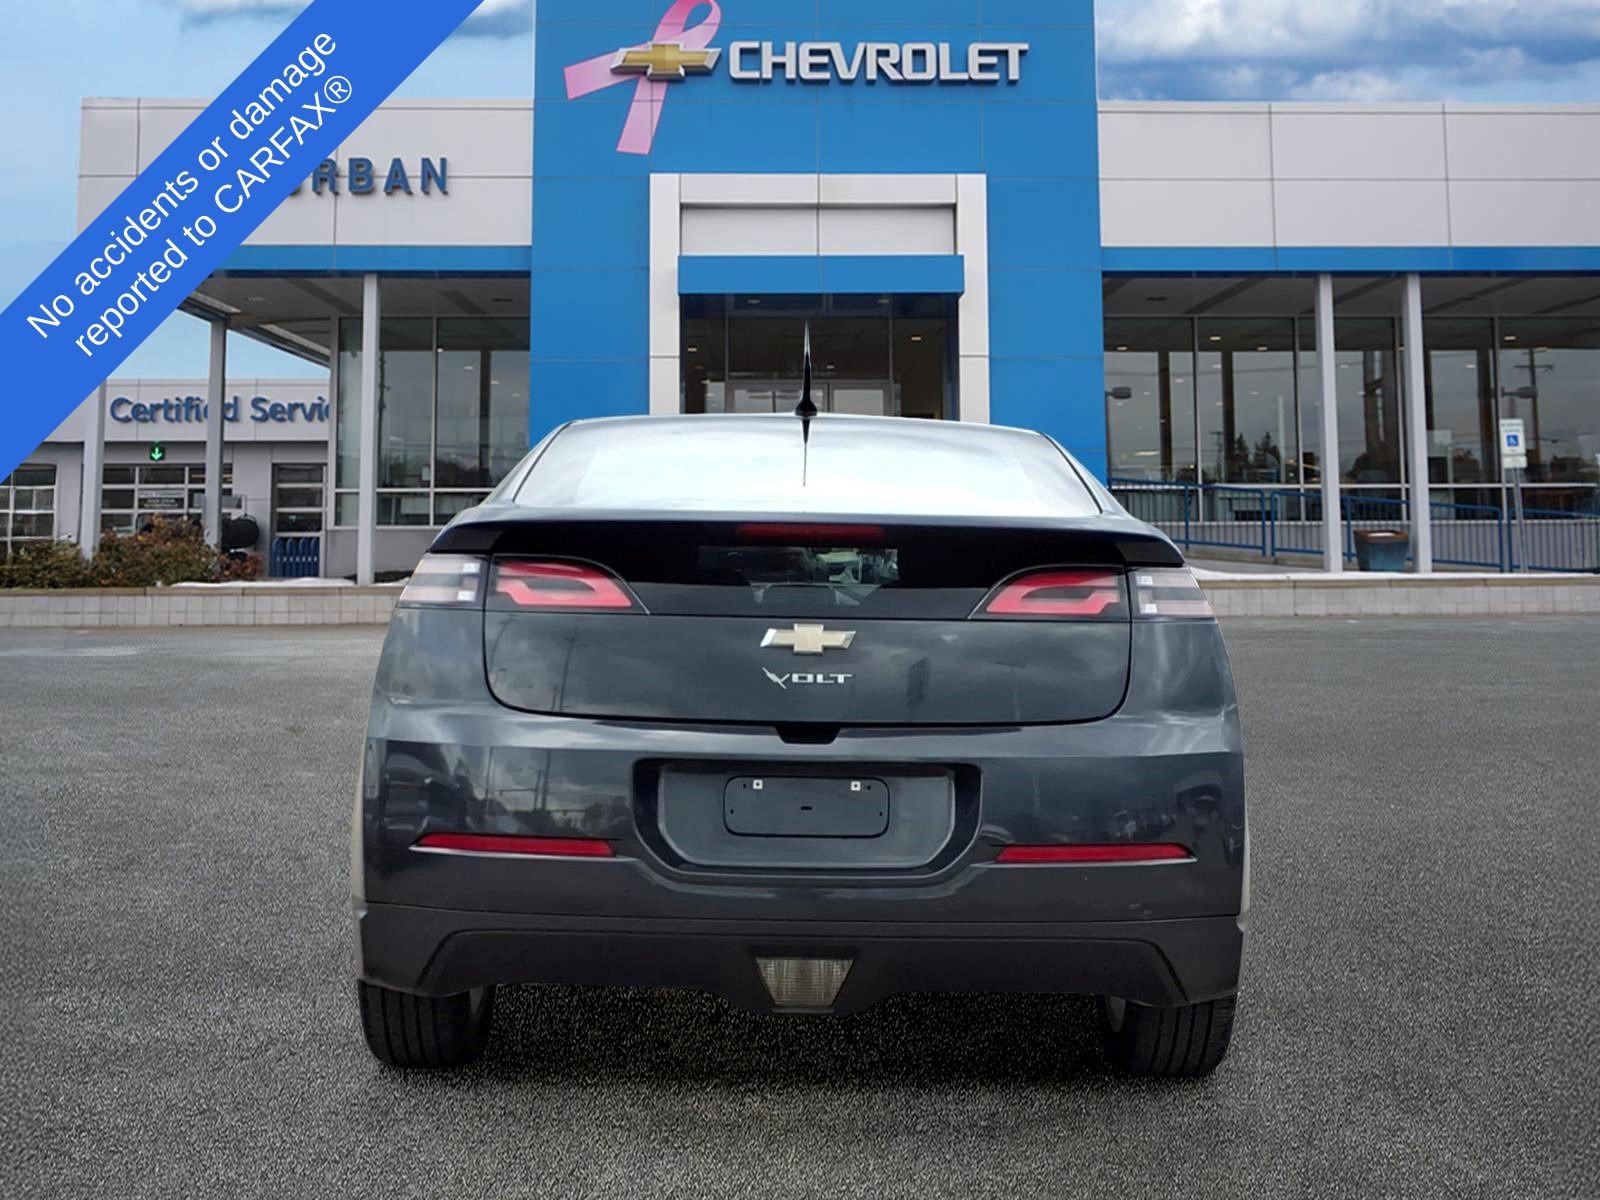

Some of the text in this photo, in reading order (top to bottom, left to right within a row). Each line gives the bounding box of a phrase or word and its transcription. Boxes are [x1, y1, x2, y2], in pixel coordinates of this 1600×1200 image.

[729, 41, 1029, 81] CHEVROLET
[289, 157, 449, 195] RBAN
[110, 396, 330, 423] Certifid Servi
[762, 667, 853, 690] VOLT
